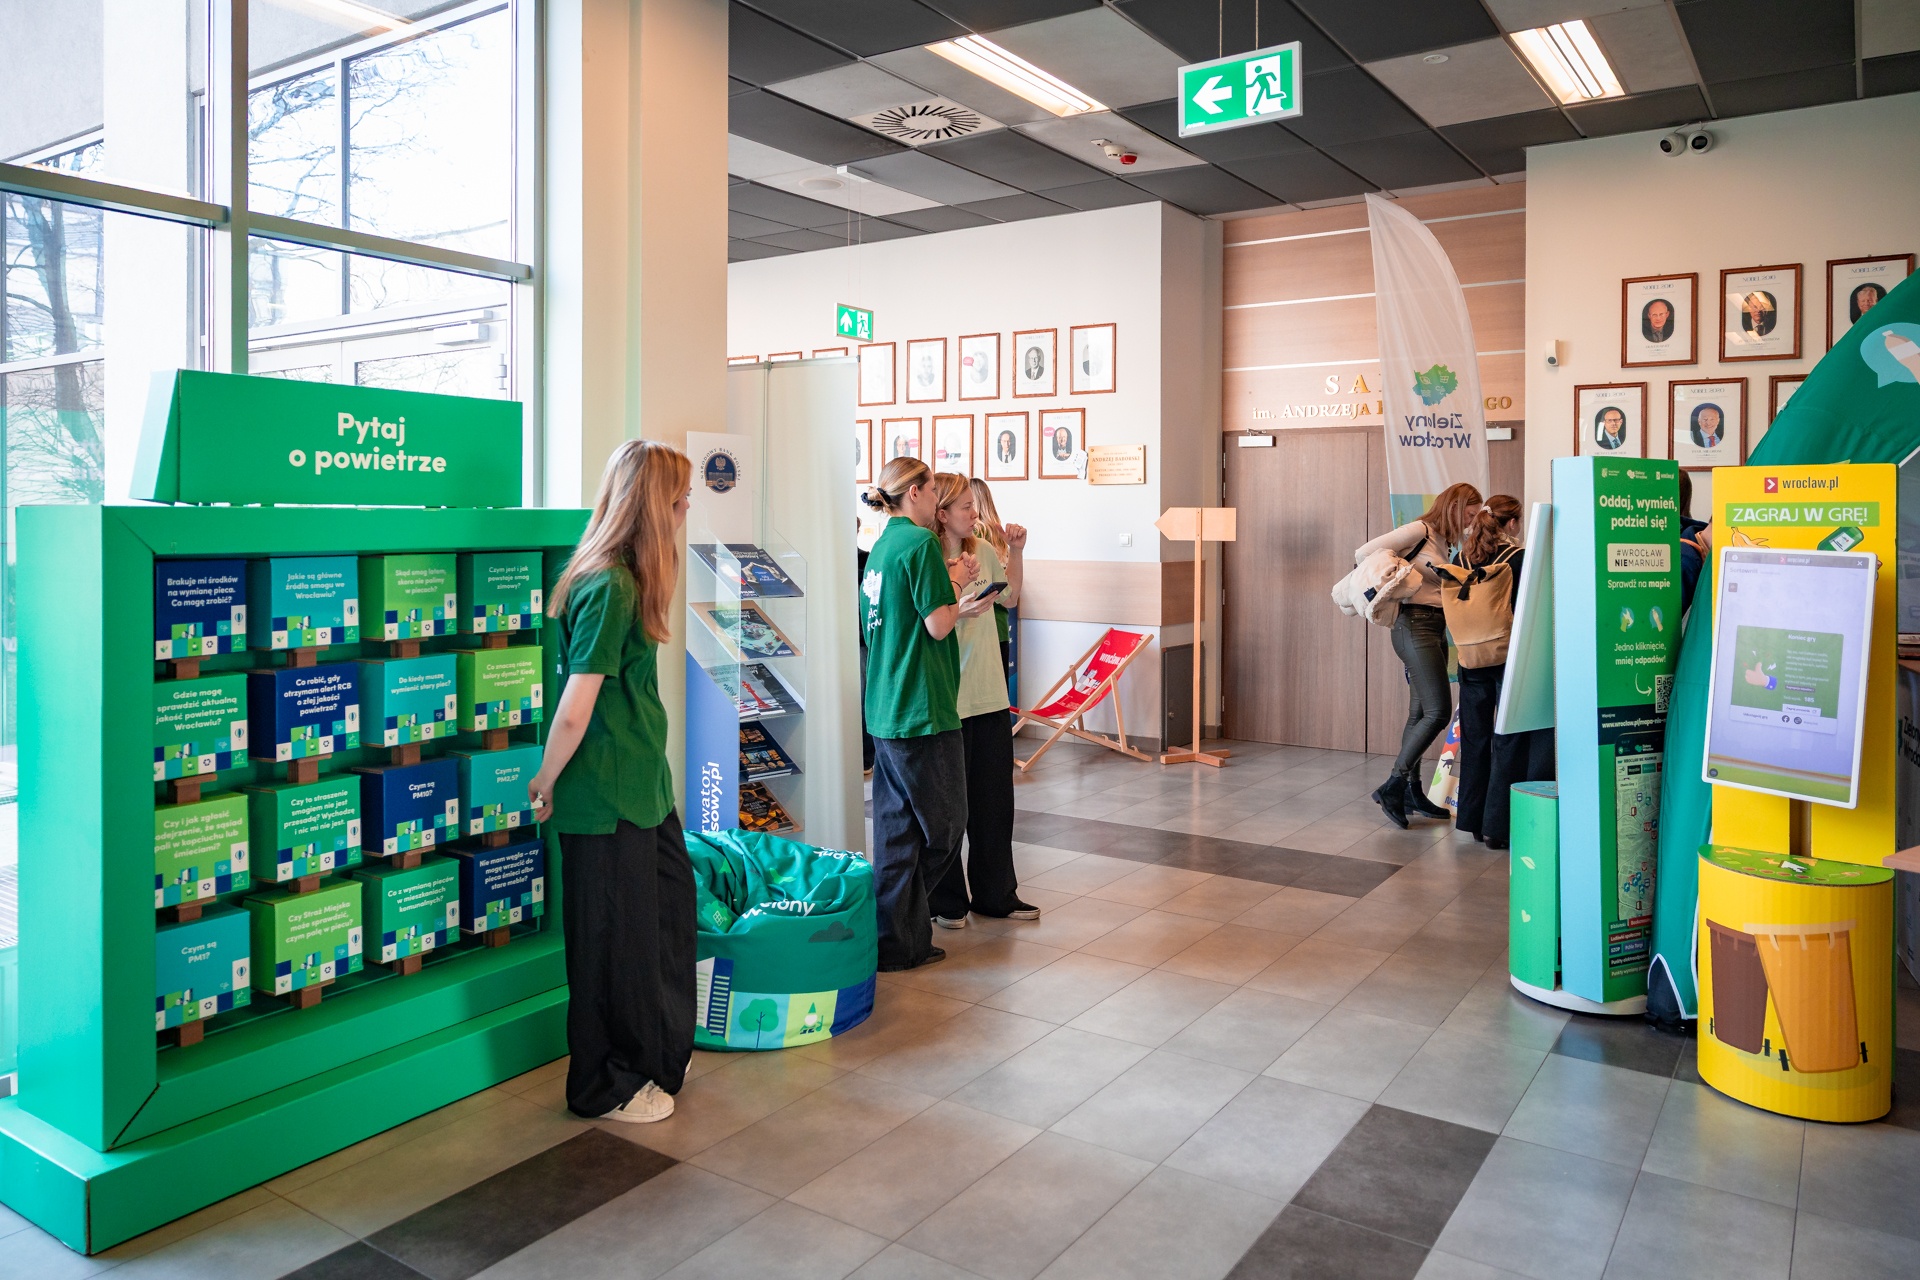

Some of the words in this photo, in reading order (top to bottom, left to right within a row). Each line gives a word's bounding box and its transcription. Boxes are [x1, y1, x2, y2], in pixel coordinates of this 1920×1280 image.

[1253, 408, 1276, 419] im.
[1281, 403, 1371, 419] ANDRZEJA
[338, 412, 405, 446] Pytaj
[289, 449, 306, 467] o
[315, 446, 446, 475] powietrze
[1782, 476, 1839, 490] wroclaw.pl
[1600, 495, 1633, 510] Oddaj,
[1636, 496, 1678, 511] wymień,
[1611, 515, 1648, 530] podziel
[1651, 515, 1667, 530] się!
[1732, 508, 1799, 522] ZAGRAJ
[1804, 508, 1824, 521] W
[1828, 508, 1868, 525] GRĘ!
[1617, 549, 1662, 557] #WROCŁAW
[1615, 559, 1664, 567] NIEMARNUJE
[287, 573, 305, 582] Jakie
[317, 572, 342, 580] główne
[395, 569, 410, 577] Skąd
[167, 577, 196, 587] Brakuje
[208, 576, 238, 584] środków
[286, 582, 309, 590] źródła
[425, 577, 444, 585] palimy
[1608, 579, 1637, 589] Sprawdź
[1649, 578, 1670, 589] mapie
[180, 588, 212, 597] wymianę
[214, 587, 236, 595] pieca.
[295, 591, 336, 599] Wrocławiu?
[412, 586, 437, 595] piecach?
[184, 599, 205, 607] mogę
[206, 596, 232, 604] zrobić?
[1614, 643, 1634, 651] Jedno
[1636, 641, 1666, 651] kliknięcie,
[1616, 656, 1633, 666] mniej
[1635, 655, 1666, 665] odpadów!
[307, 676, 326, 685] robić,
[328, 674, 340, 684] gdy
[501, 670, 519, 678] dymu?
[284, 688, 319, 697] otrzymam
[338, 682, 352, 690] RCB
[391, 684, 419, 694] wymienić
[436, 680, 451, 689] piec?
[494, 678, 525, 687] reagować?
[173, 691, 197, 699] Gdzie
[303, 697, 316, 705] złej
[316, 693, 340, 704] jakości
[157, 700, 199, 713] sprawdzić
[202, 697, 237, 706] aktualną
[300, 703, 338, 717] powietrza?
[156, 713, 183, 725] jakość
[185, 708, 225, 720] powietrza
[174, 718, 221, 731] Wrocławiu?
[497, 774, 518, 783] PM2,5?
[314, 790, 348, 801] straszenie
[413, 790, 432, 799] PM10?
[702, 765, 711, 833] rwator
[708, 761, 722, 832] sowy.pl
[292, 806, 323, 816] smogiem
[335, 799, 348, 809] jest
[185, 816, 198, 826] jak
[201, 810, 230, 822] zgłosić
[284, 814, 320, 829] przesadą?
[321, 808, 355, 820] Wychodzę
[331, 819, 345, 829] jest.
[155, 827, 202, 841] odejrzenie,
[216, 818, 243, 829] sąsiad
[154, 842, 171, 854] pali
[182, 833, 224, 846] kopciuchu
[174, 843, 221, 858] śmieciami?
[506, 852, 524, 860] węgla
[486, 866, 502, 874] mogę
[503, 859, 525, 869] wrzucić
[485, 876, 501, 884] pieca
[502, 869, 520, 878] śmieci
[491, 882, 506, 890] stare
[507, 875, 528, 885] meble?
[403, 882, 431, 893] wymianą
[433, 877, 454, 887] pieców
[404, 886, 446, 902] mieszkaniach
[304, 908, 322, 918] Straż
[324, 902, 350, 913] Miejska
[399, 895, 443, 912] komunalnych?
[291, 922, 310, 932] może
[312, 911, 348, 927] sprawdzić,
[286, 934, 304, 943] czym
[306, 929, 322, 939] palę
[331, 919, 353, 932] piecu?
[181, 945, 205, 954] Czym
[188, 952, 210, 963] PM1?
